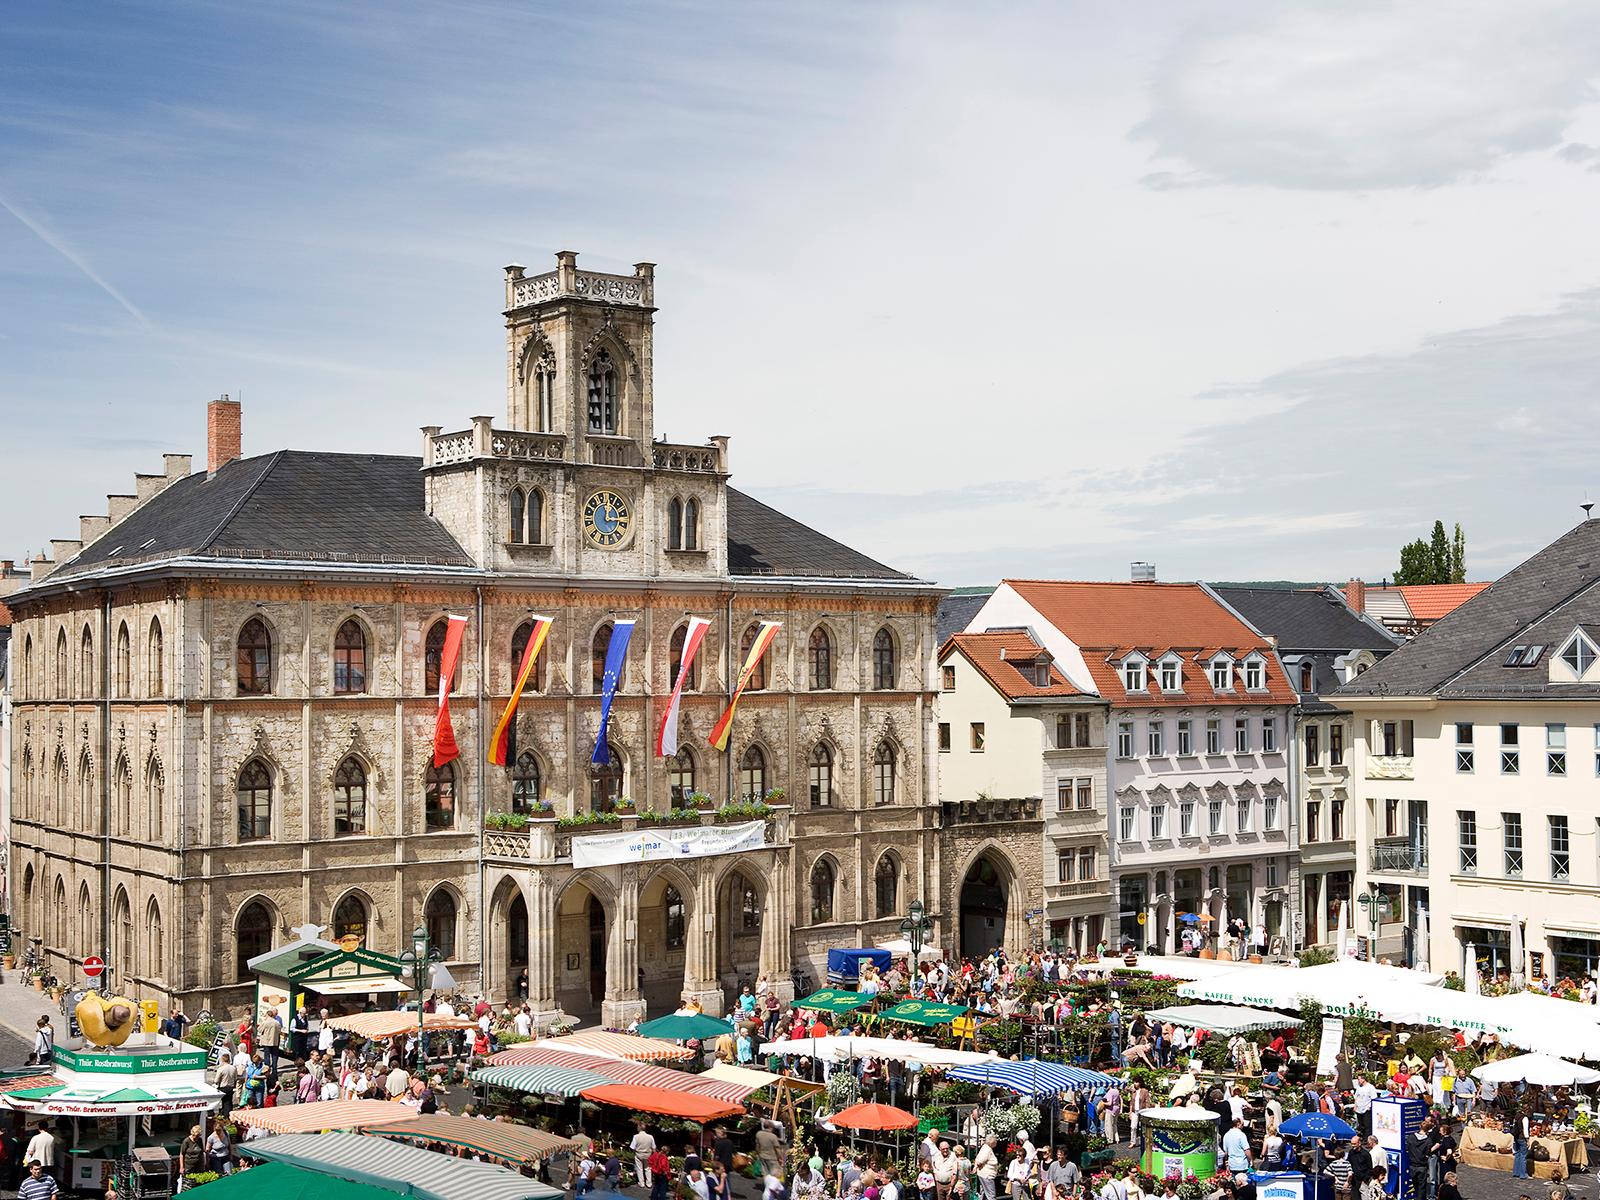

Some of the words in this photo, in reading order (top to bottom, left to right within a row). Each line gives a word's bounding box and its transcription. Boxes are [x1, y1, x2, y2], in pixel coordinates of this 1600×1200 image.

[629, 837, 661, 858] weimar
[1204, 992, 1233, 1001] KAFFEE
[1242, 996, 1274, 1005] SNACKS
[1427, 1015, 1441, 1024] EIS
[1452, 1019, 1486, 1030] KAFFEE
[78, 1058, 93, 1067] Thür.
[94, 1059, 133, 1068] Rostbratwurst
[141, 1059, 157, 1068] Thür.
[158, 1057, 199, 1067] Rostbratwurst
[48, 1105, 65, 1113] Orig.
[66, 1105, 82, 1113] Thür.
[157, 1103, 175, 1111] Thür.
[175, 1101, 208, 1110] Bratwurst
